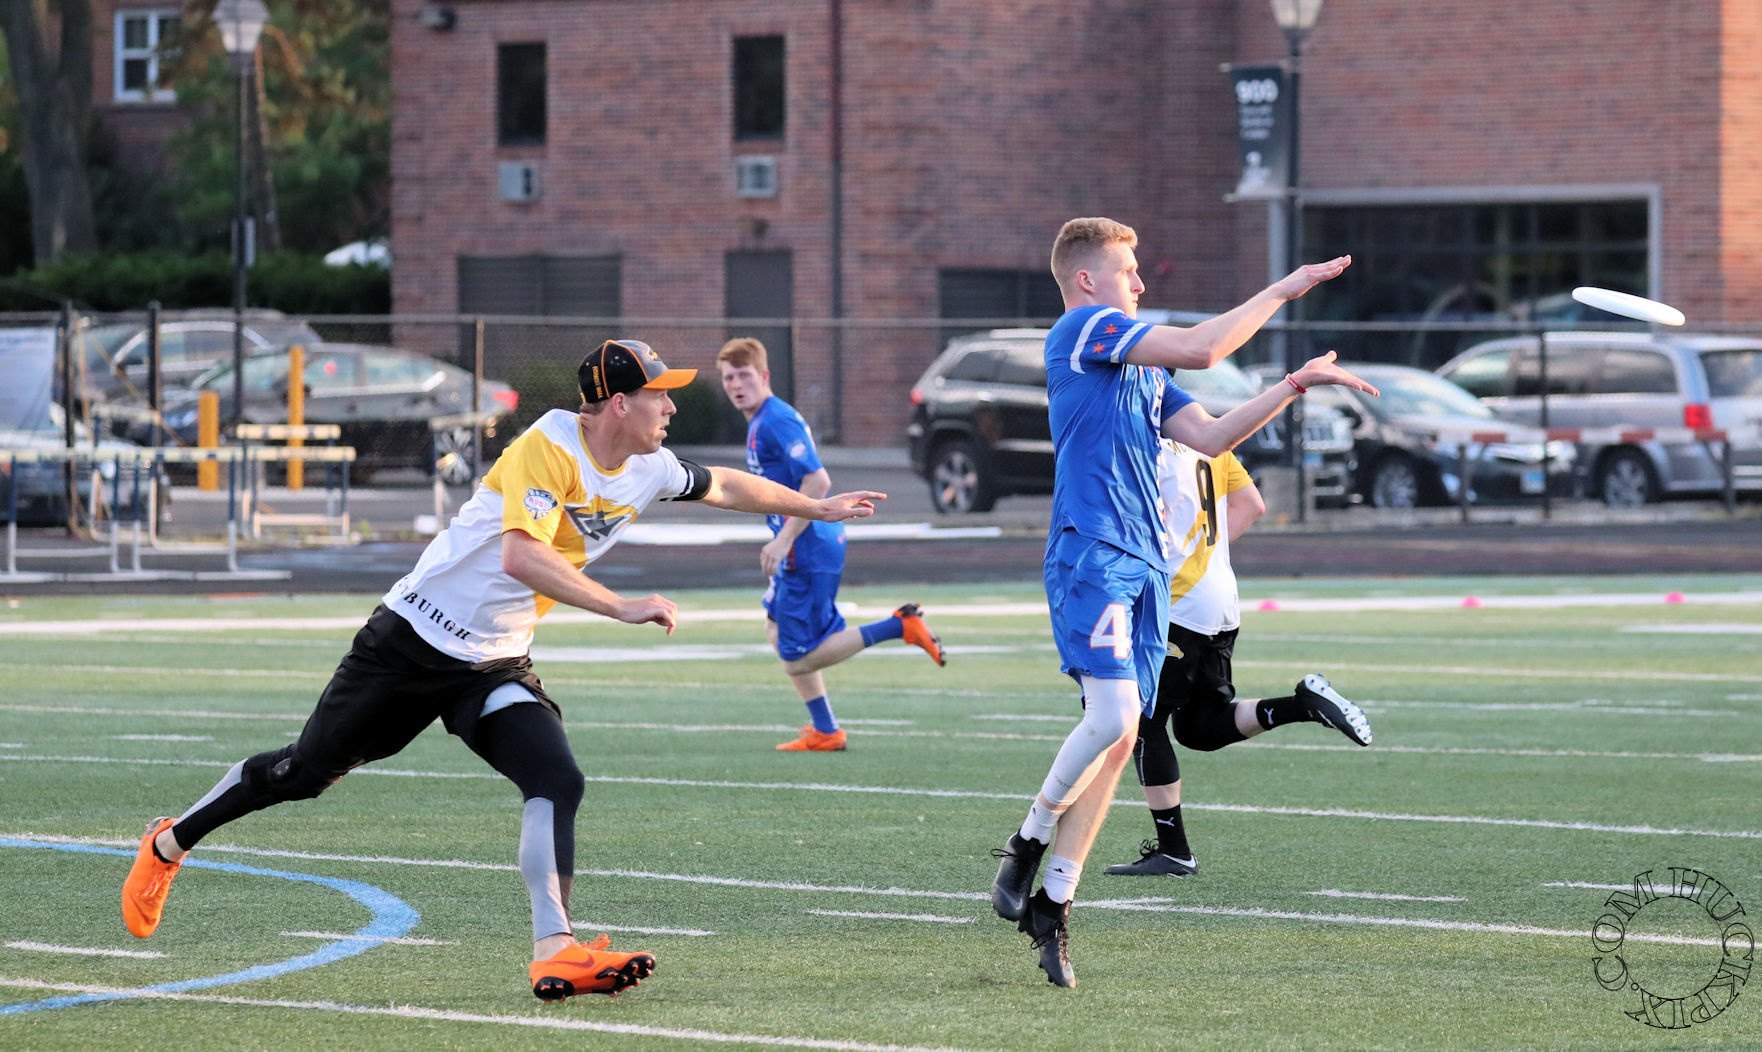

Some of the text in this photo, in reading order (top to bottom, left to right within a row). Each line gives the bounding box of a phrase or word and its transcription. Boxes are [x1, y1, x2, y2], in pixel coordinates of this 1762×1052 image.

[1195, 457, 1218, 547] 9
[401, 585, 472, 640] BURGH
[1090, 603, 1132, 660] 4
